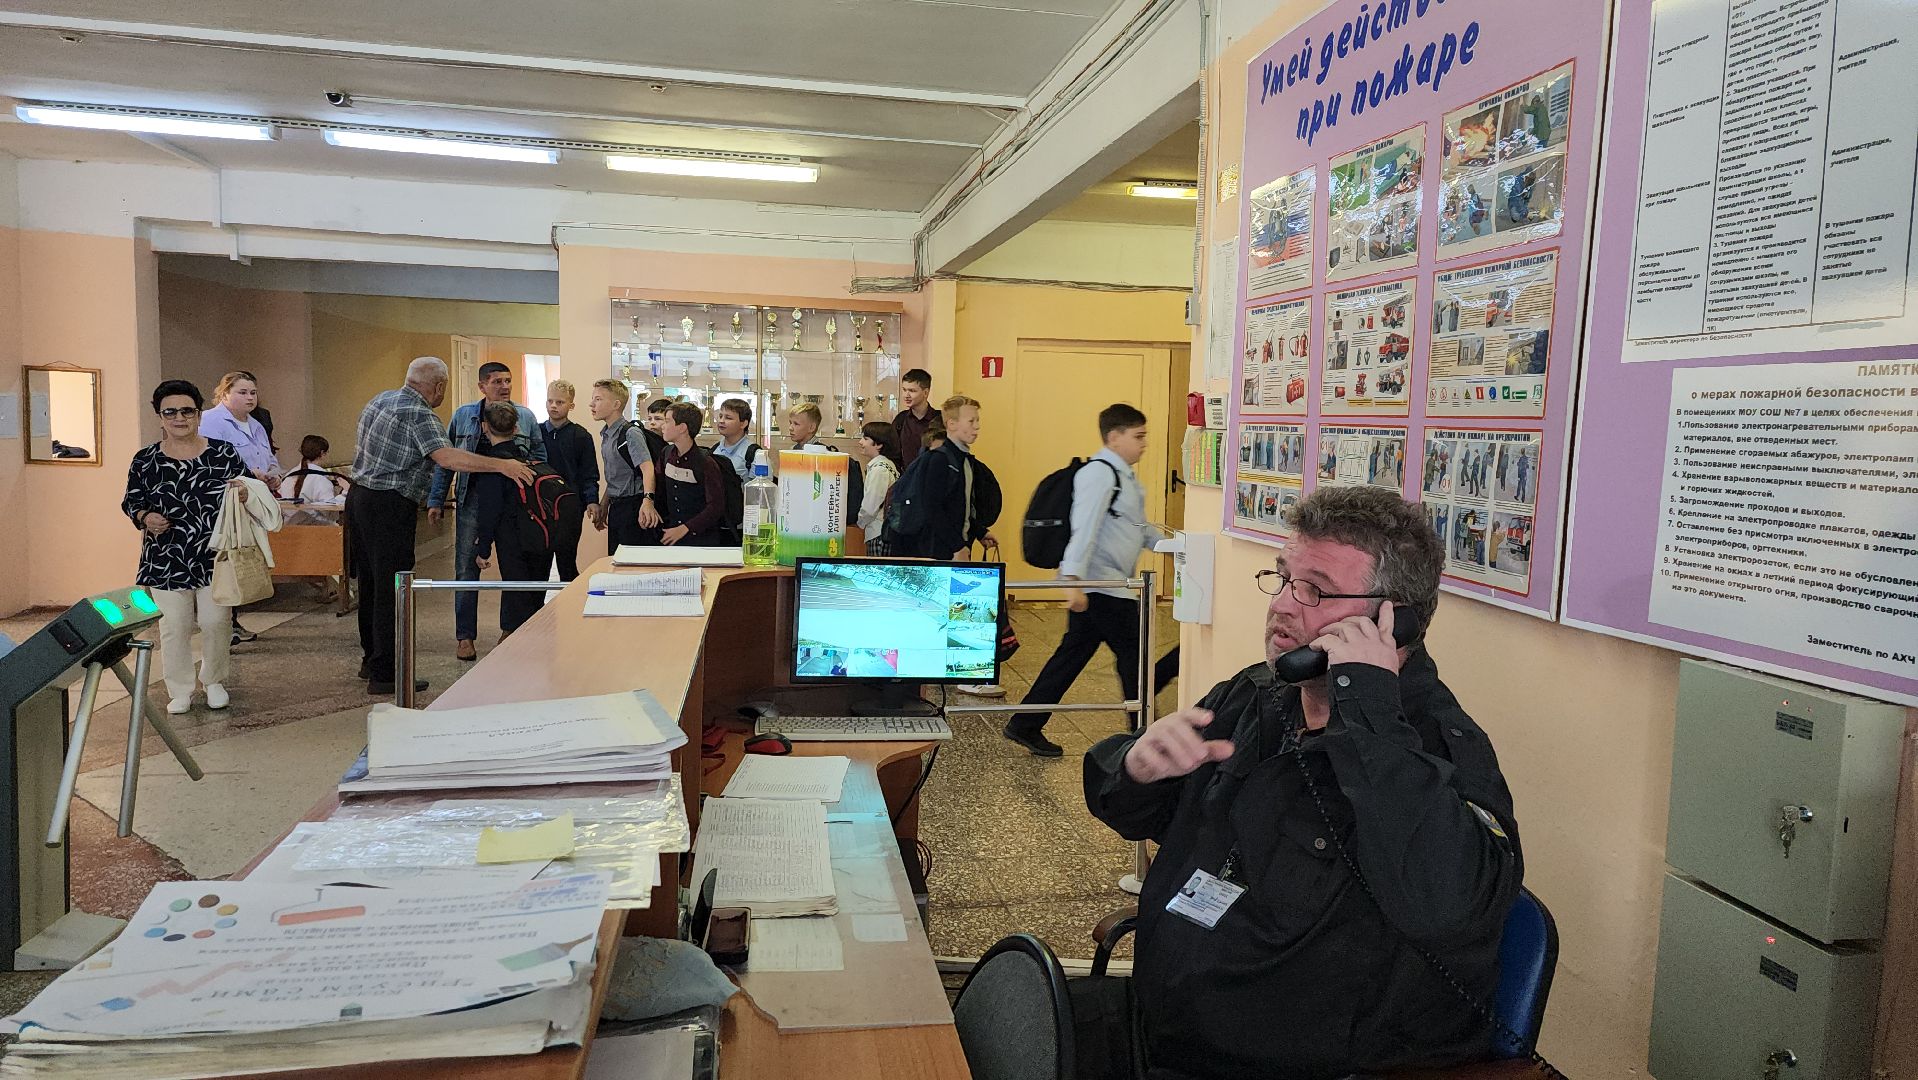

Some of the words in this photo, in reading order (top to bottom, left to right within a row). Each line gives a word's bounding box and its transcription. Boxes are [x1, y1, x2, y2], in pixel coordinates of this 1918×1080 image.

[1261, 37, 1312, 106] Умей
[1316, 0, 1446, 85] дейст
[1296, 92, 1342, 147] при
[1351, 21, 1479, 116] пожаре
[1692, 392, 1697, 400] о
[1701, 391, 1736, 400] мерах
[1740, 387, 1802, 400] пожарной
[1806, 387, 1906, 398] безопасности
[1784, 408, 1801, 416] №7
[1812, 410, 1840, 418] целях
[1844, 409, 1913, 417] обеспечения
[1742, 423, 1864, 432] электронагревательными
[1684, 435, 1733, 443] материалов,
[1754, 436, 1809, 445] отведенных
[1684, 446, 1736, 456] Применение
[1739, 450, 1788, 458] сгораемых
[1791, 451, 1840, 462] абажуров,
[1844, 454, 1914, 463] электроламп
[1674, 458, 1680, 466] 3.
[1683, 459, 1738, 469] Пользование
[1740, 464, 1808, 472] неисправными
[1812, 467, 1898, 479] выключателями,
[1682, 471, 1721, 480] Хранение
[1806, 482, 1847, 490] веществ
[1688, 486, 1722, 494] горючих
[1679, 496, 1745, 508] Загромождение
[1748, 503, 1789, 514] проходов
[1801, 508, 1846, 518] выходов.
[1678, 509, 1722, 519] Крепление
[1738, 516, 1816, 529] электропроводке
[1820, 524, 1869, 537] плакатов,
[1872, 530, 1916, 540] одежды
[1668, 520, 1674, 528] 7.
[1677, 521, 1725, 533] Оставление
[1728, 527, 1742, 535] без
[1745, 530, 1793, 541] присмотра
[1797, 537, 1860, 550] включенных
[1873, 545, 1918, 556] электро
[1675, 534, 1749, 551] электроприборов,
[1753, 545, 1807, 557] оргтехники.
[1674, 546, 1715, 558] Установка
[1718, 553, 1791, 570] электророзеток,
[1794, 563, 1817, 572] если
[1820, 567, 1836, 575] это
[1840, 570, 1852, 578] не
[1855, 572, 1918, 587] обусловлен
[1672, 558, 1712, 570] Хранение
[1728, 568, 1753, 577] окнах
[1763, 574, 1796, 584] летний
[1799, 578, 1834, 590] период
[1837, 583, 1918, 603] фокусирующи
[1674, 571, 1725, 586] Применение
[1728, 581, 1772, 594] открытого
[1775, 588, 1798, 600] огня,
[1801, 592, 1871, 611] производство
[1699, 590, 1747, 603] документа.
[1807, 635, 1872, 656] Заместитель
[1876, 651, 1888, 659] по
[1892, 652, 1916, 665] АХЧ
